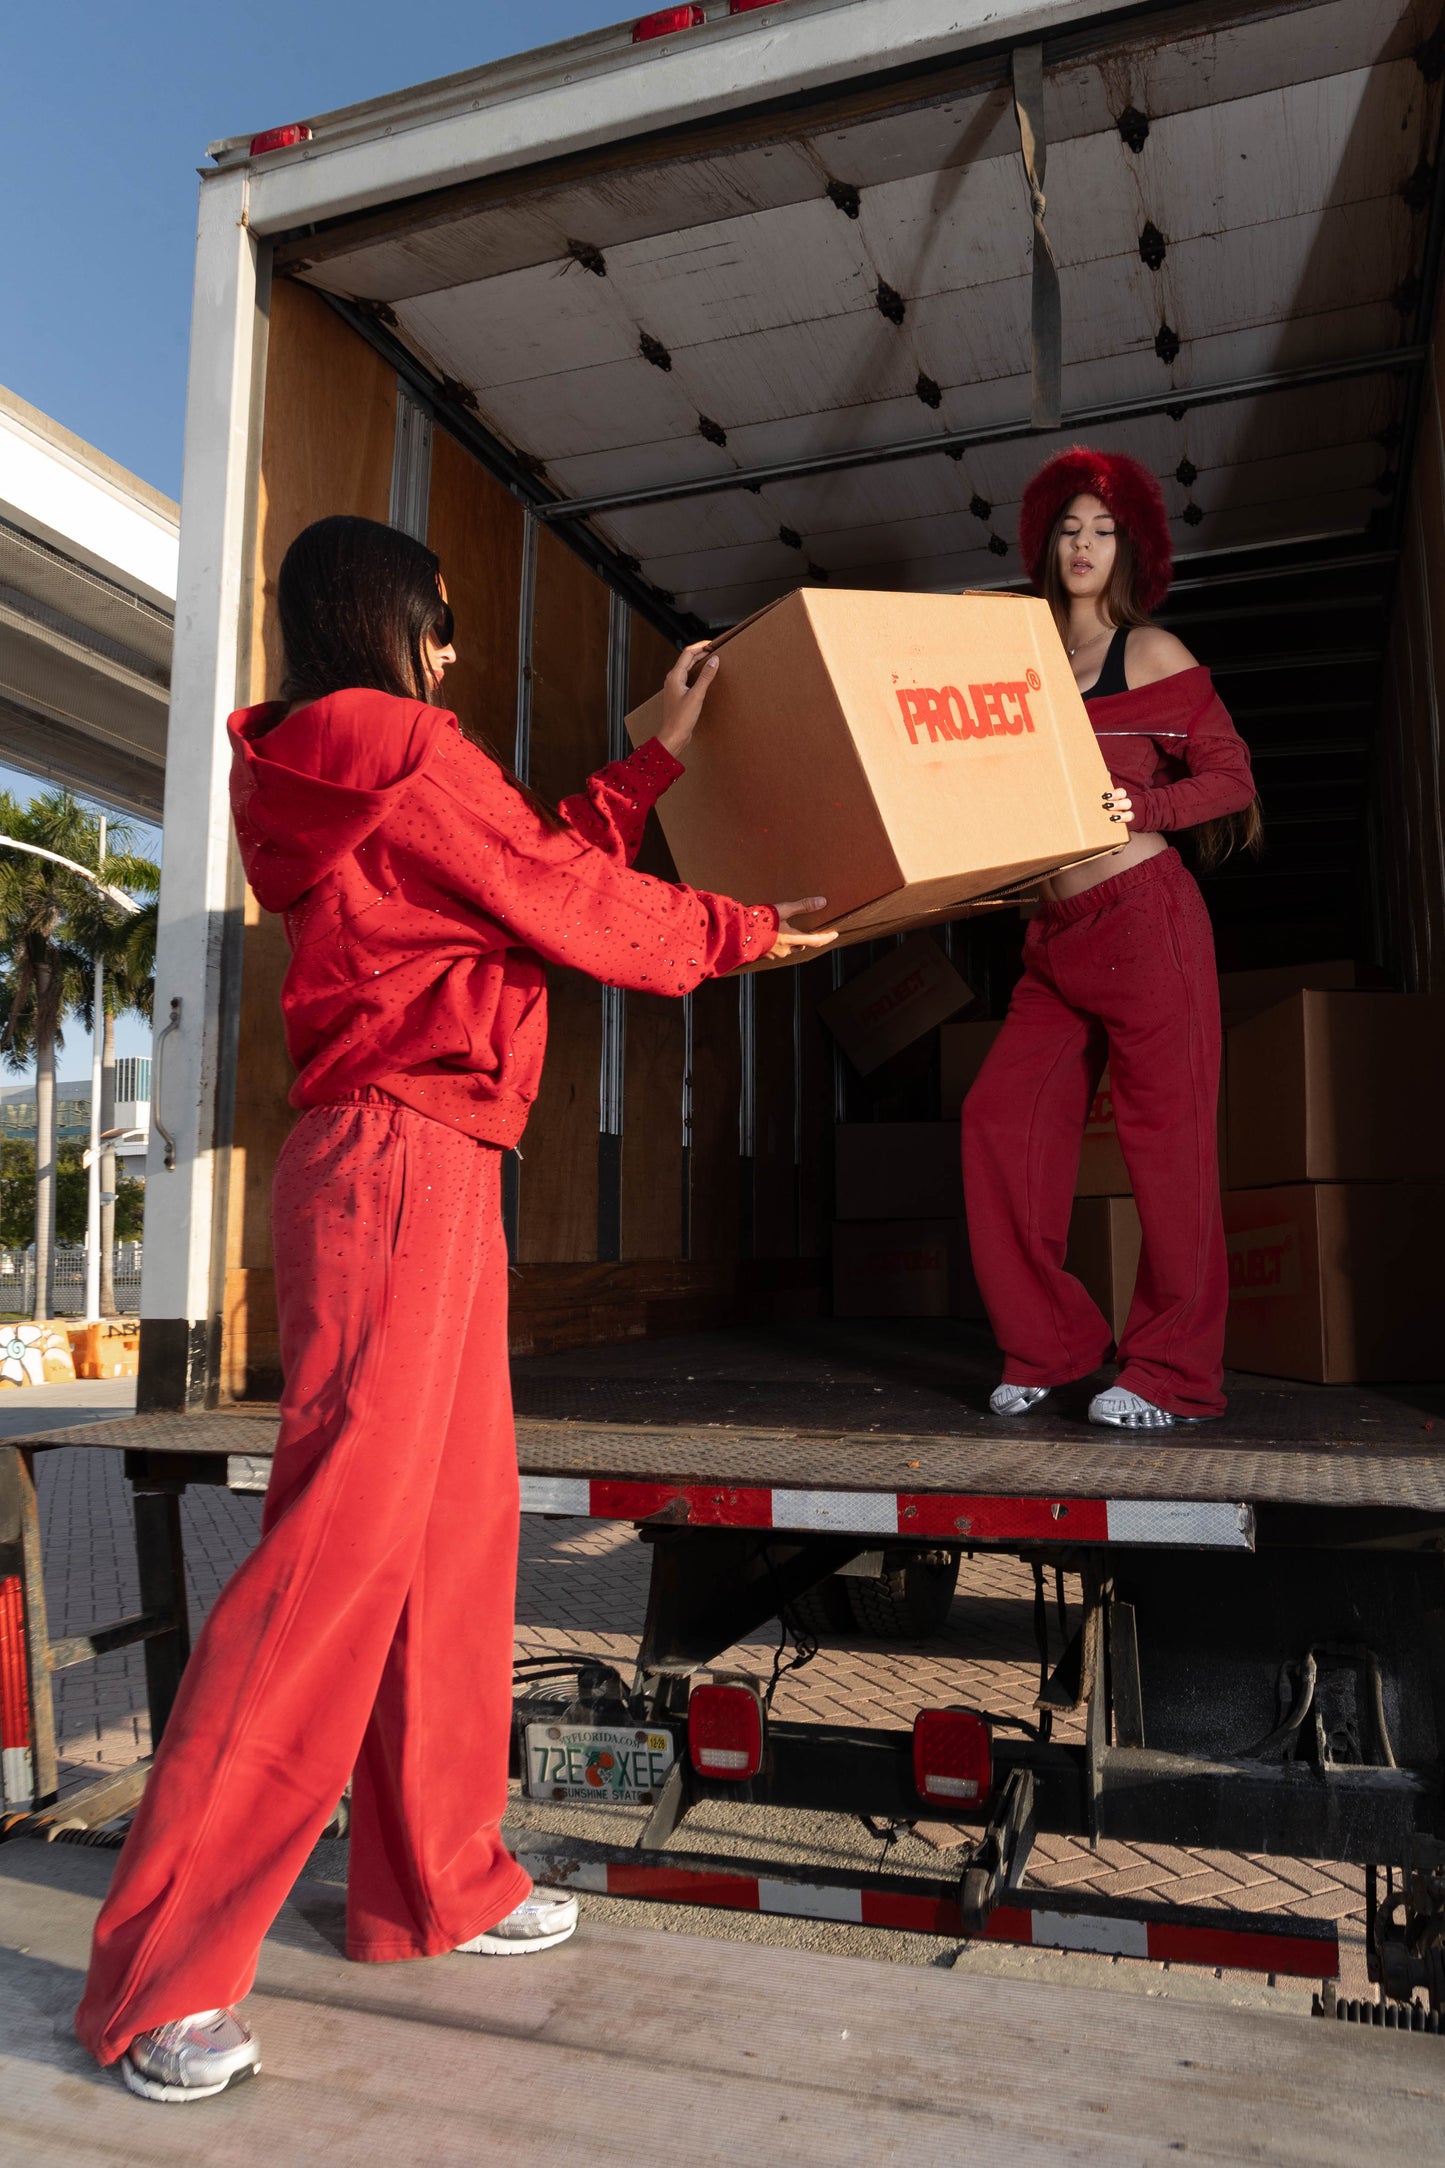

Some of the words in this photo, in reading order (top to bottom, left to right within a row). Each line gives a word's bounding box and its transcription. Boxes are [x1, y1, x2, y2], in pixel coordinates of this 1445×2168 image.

[533, 1747, 584, 1784] 72E
[616, 1751, 665, 1788] XEE
[562, 1787, 608, 1800] SUNSHINE
